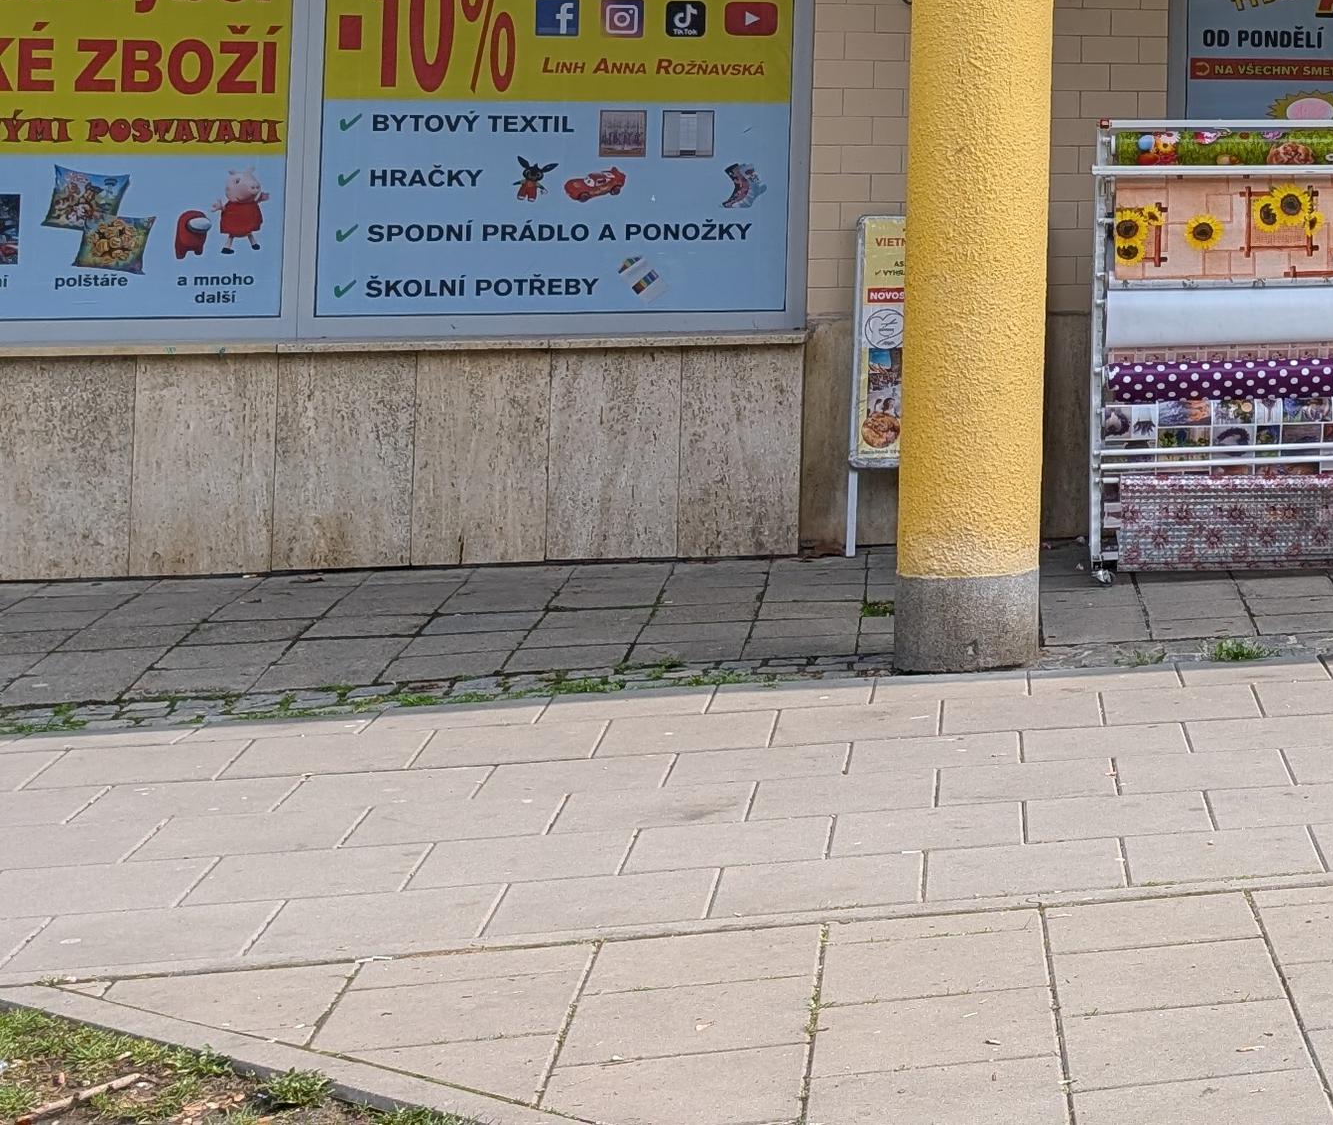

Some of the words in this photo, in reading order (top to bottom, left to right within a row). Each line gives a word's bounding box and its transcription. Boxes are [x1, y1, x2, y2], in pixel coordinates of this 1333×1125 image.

[1203, 29, 1230, 48] OD
[1237, 26, 1325, 49] PONDĚLÍ
[74, 25, 283, 95] ZBOŽÍ
[1214, 64, 1234, 75] NA
[1238, 61, 1300, 76] VŠECHNY
[86, 118, 284, 143] POSTAVAMI
[372, 110, 479, 133] BYTOVÝ
[488, 114, 575, 133] TEXTIL
[369, 164, 484, 188] HRAČKY
[367, 220, 473, 243] SPODNÍ
[481, 219, 590, 242] PRÁDLO
[598, 224, 617, 242] A
[625, 218, 753, 241] PONOŽKY
[54, 273, 128, 291] polštáře
[177, 277, 188, 286] a
[194, 273, 254, 287] mnoho
[365, 274, 466, 298] ŠKOLNÍ
[475, 272, 600, 297] POTŘEBY
[195, 290, 236, 304] další
